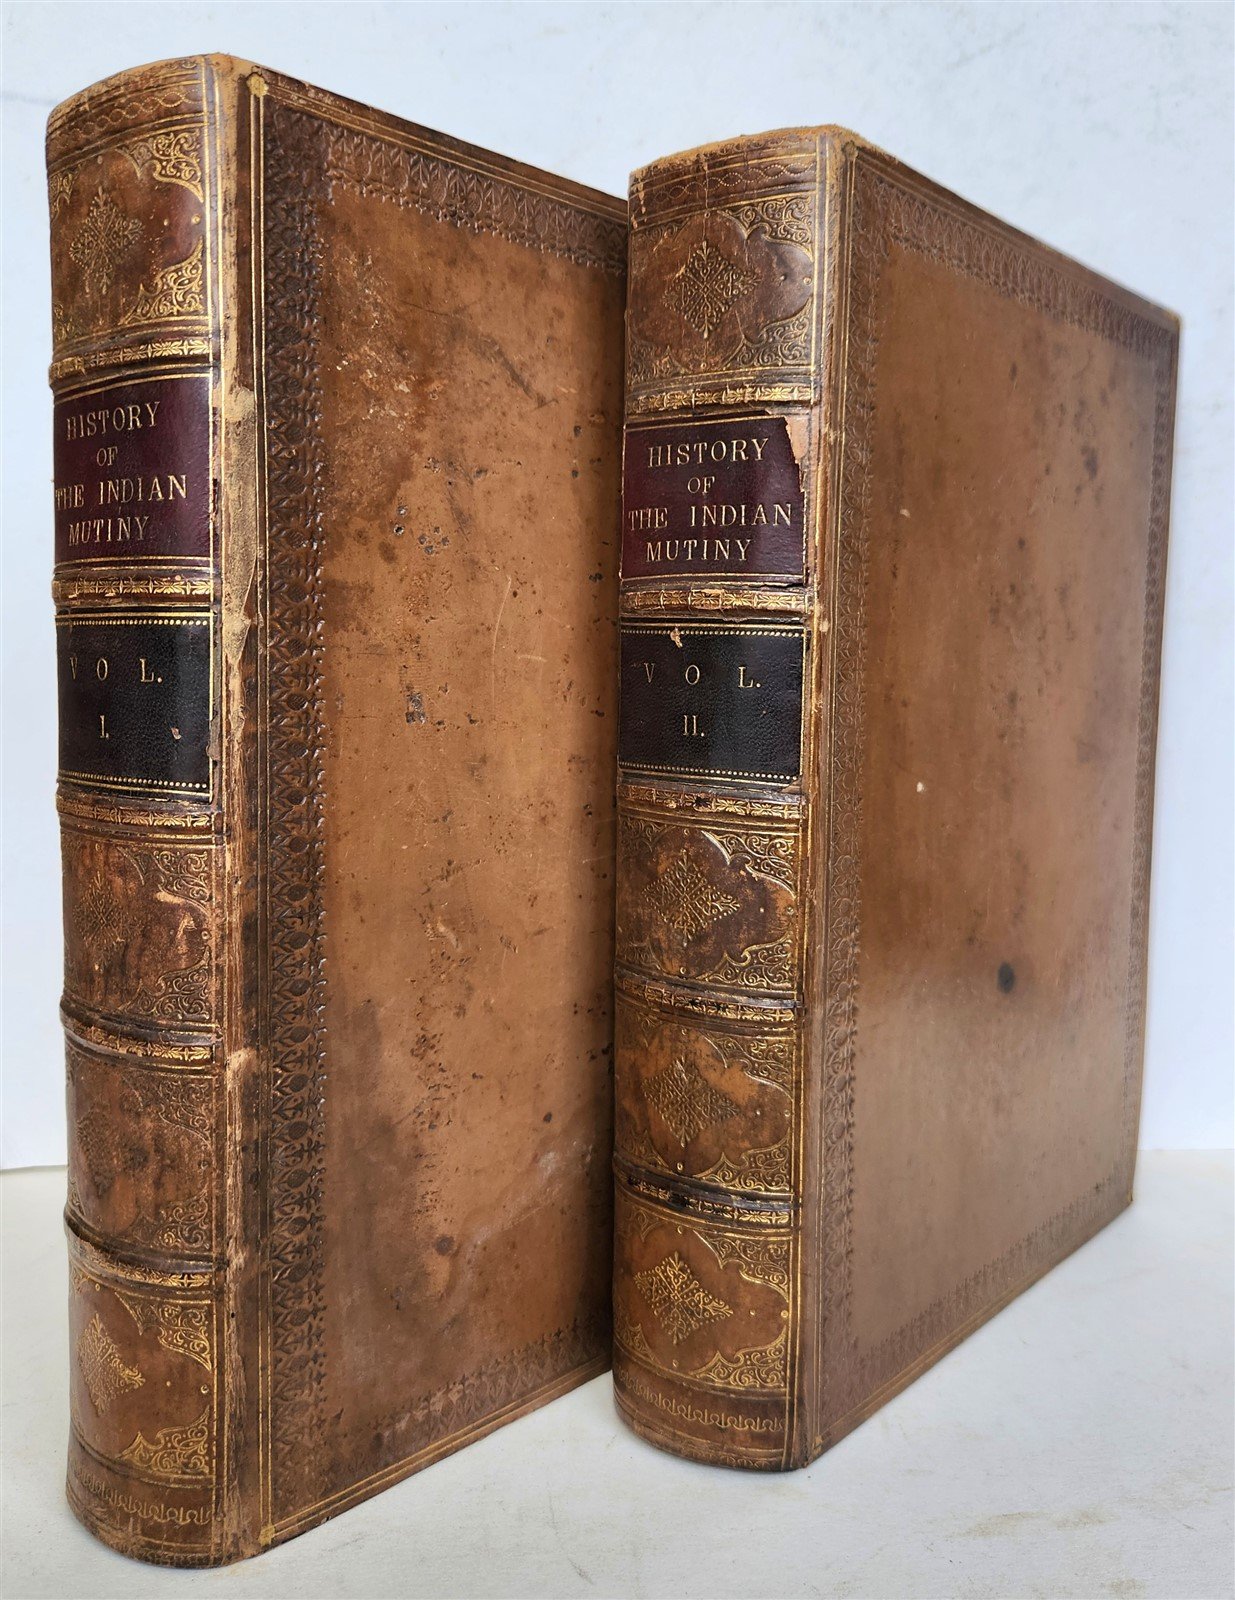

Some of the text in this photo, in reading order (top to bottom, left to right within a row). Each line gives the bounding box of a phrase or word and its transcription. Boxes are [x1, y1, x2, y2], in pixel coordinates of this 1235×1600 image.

[66, 401, 160, 441] HISTORY
[96, 445, 118, 467] OF
[647, 437, 769, 468] HISTORY
[55, 474, 187, 511] THE INDIAN
[687, 475, 715, 494] OF
[68, 516, 149, 546] MUTINY
[628, 503, 792, 531] THE INDIAN
[646, 539, 751, 562] MUTINY
